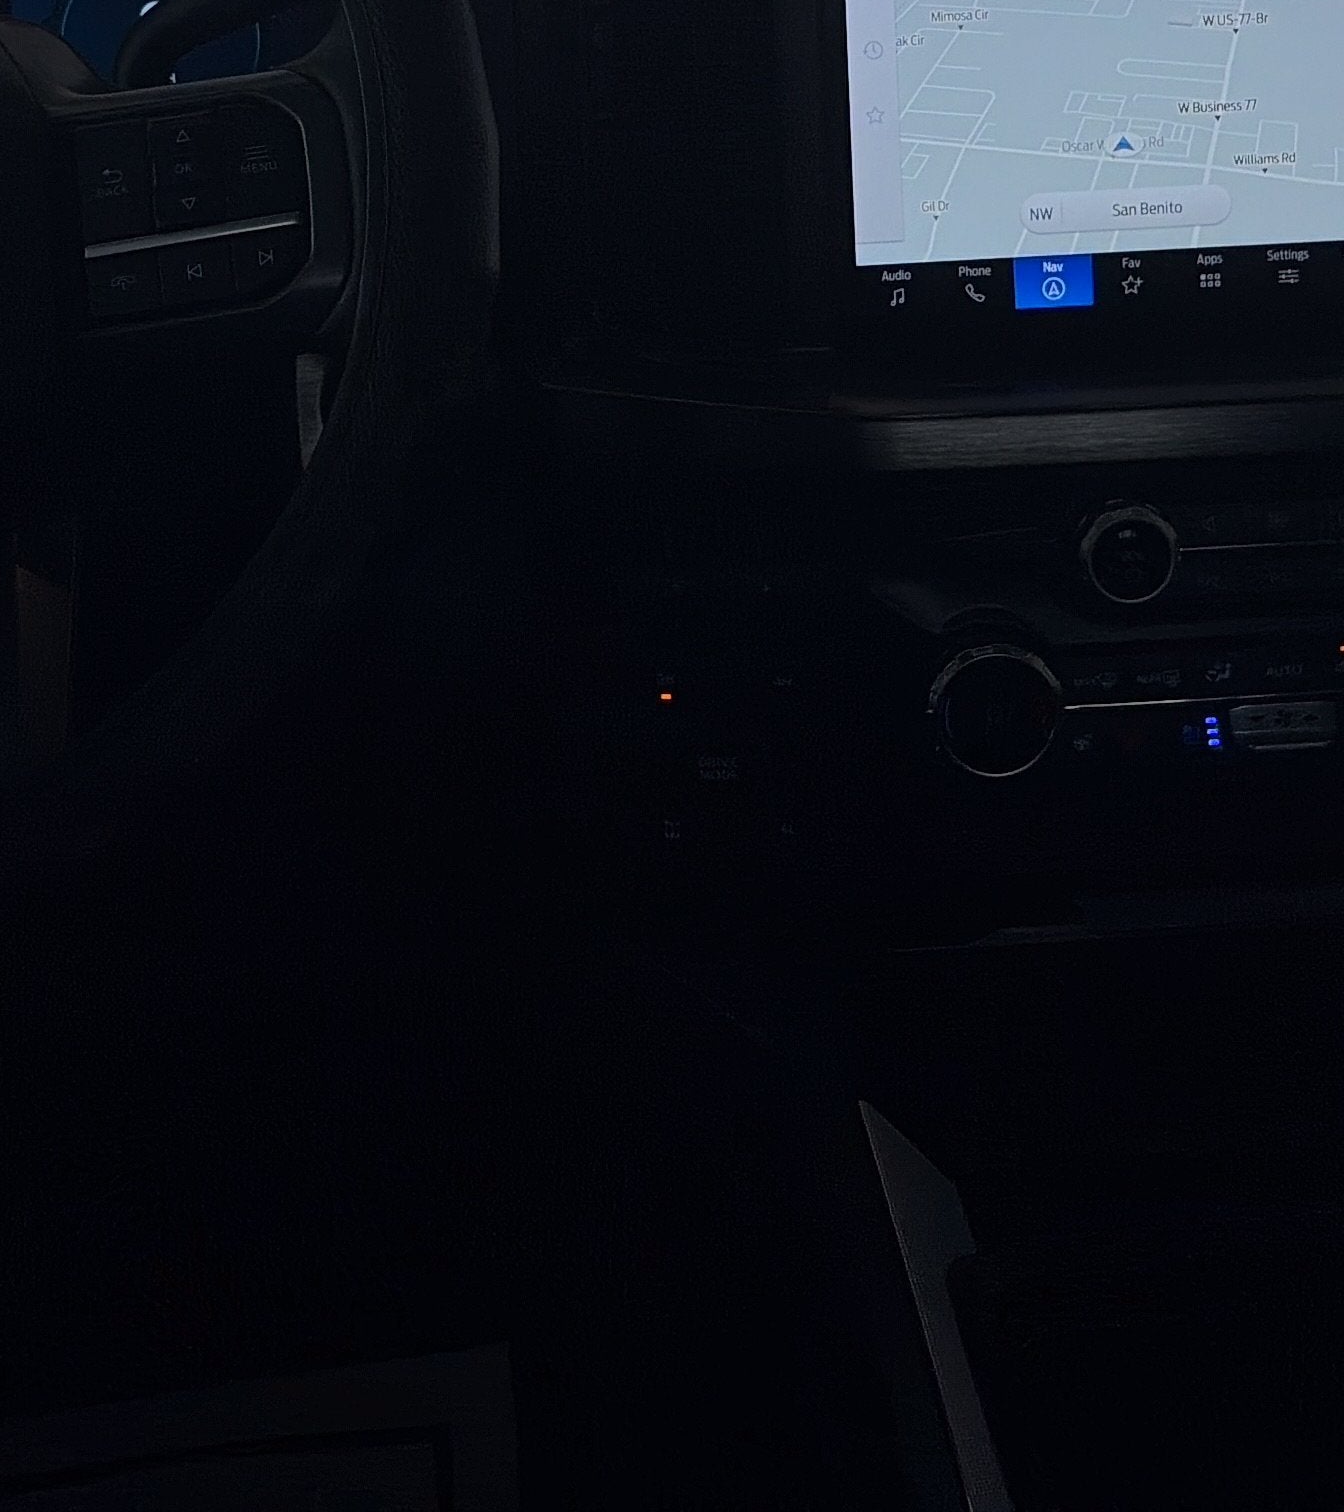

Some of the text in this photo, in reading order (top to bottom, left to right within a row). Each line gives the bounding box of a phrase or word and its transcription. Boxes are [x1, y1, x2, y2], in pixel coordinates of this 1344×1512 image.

[931, 8, 989, 22] Mimosa Cir
[1202, 13, 1269, 27] W US-77-Br
[910, 34, 925, 46] Cir
[1177, 98, 1257, 114] W Business 77
[1062, 140, 1093, 152] Oscar
[1148, 136, 1165, 148] Rd
[1233, 151, 1296, 166] Williams Rd
[920, 200, 950, 213] Gil Dr
[1112, 200, 1183, 217] San Benito
[1029, 207, 1053, 221] NW
[1196, 254, 1223, 267] Apps
[1266, 248, 1310, 263] Settings
[1042, 261, 1064, 274] Nav
[1121, 257, 1141, 270] Fav
[881, 269, 912, 283] Audio
[958, 265, 992, 279] Phone
